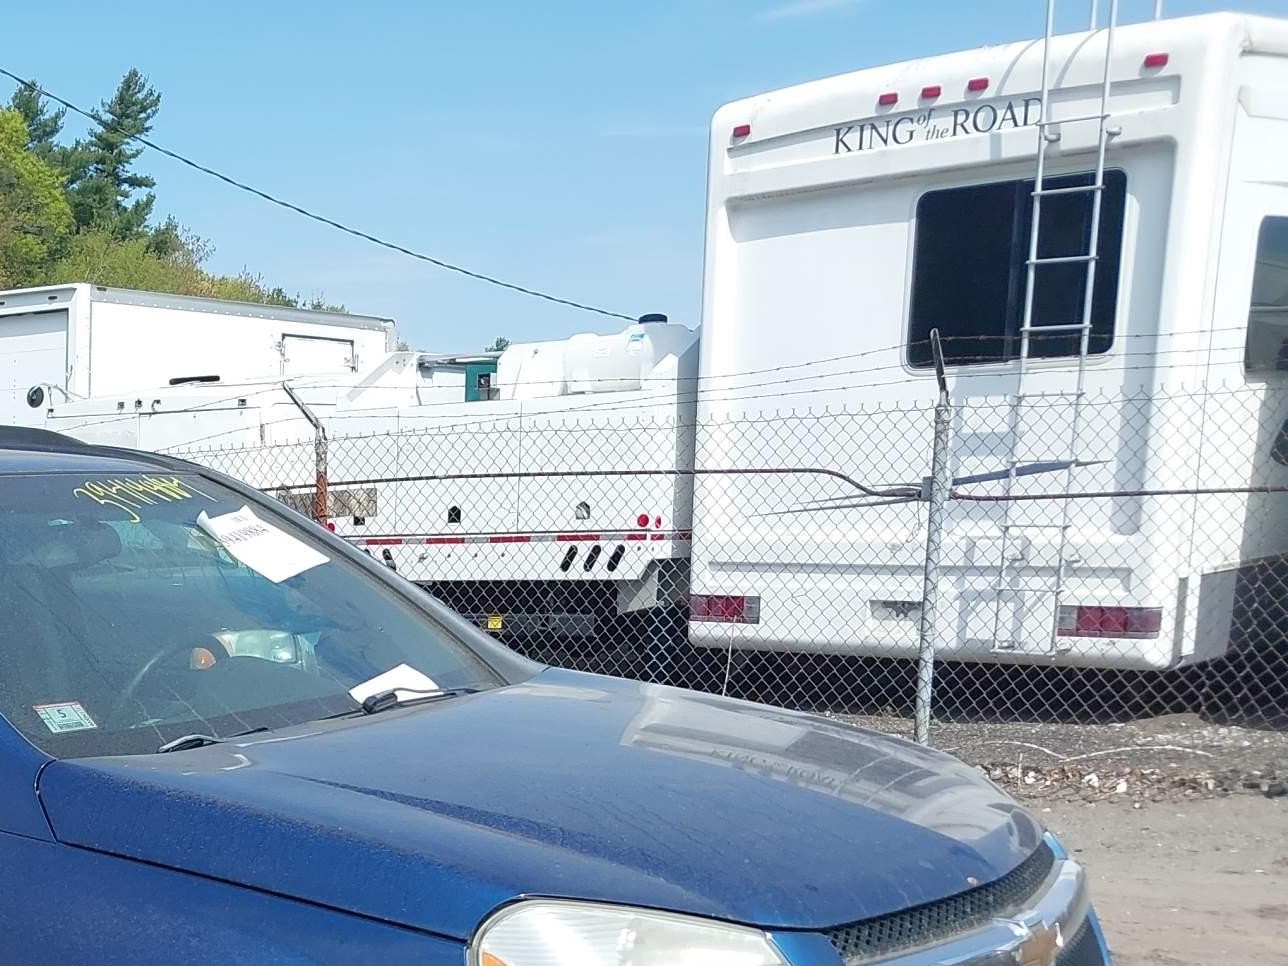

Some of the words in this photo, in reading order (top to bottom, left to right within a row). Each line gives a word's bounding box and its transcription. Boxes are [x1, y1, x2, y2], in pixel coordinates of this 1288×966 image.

[916, 108, 936, 132] of
[952, 98, 1043, 137] ROAD
[833, 117, 916, 154] KING
[925, 125, 950, 141] the
